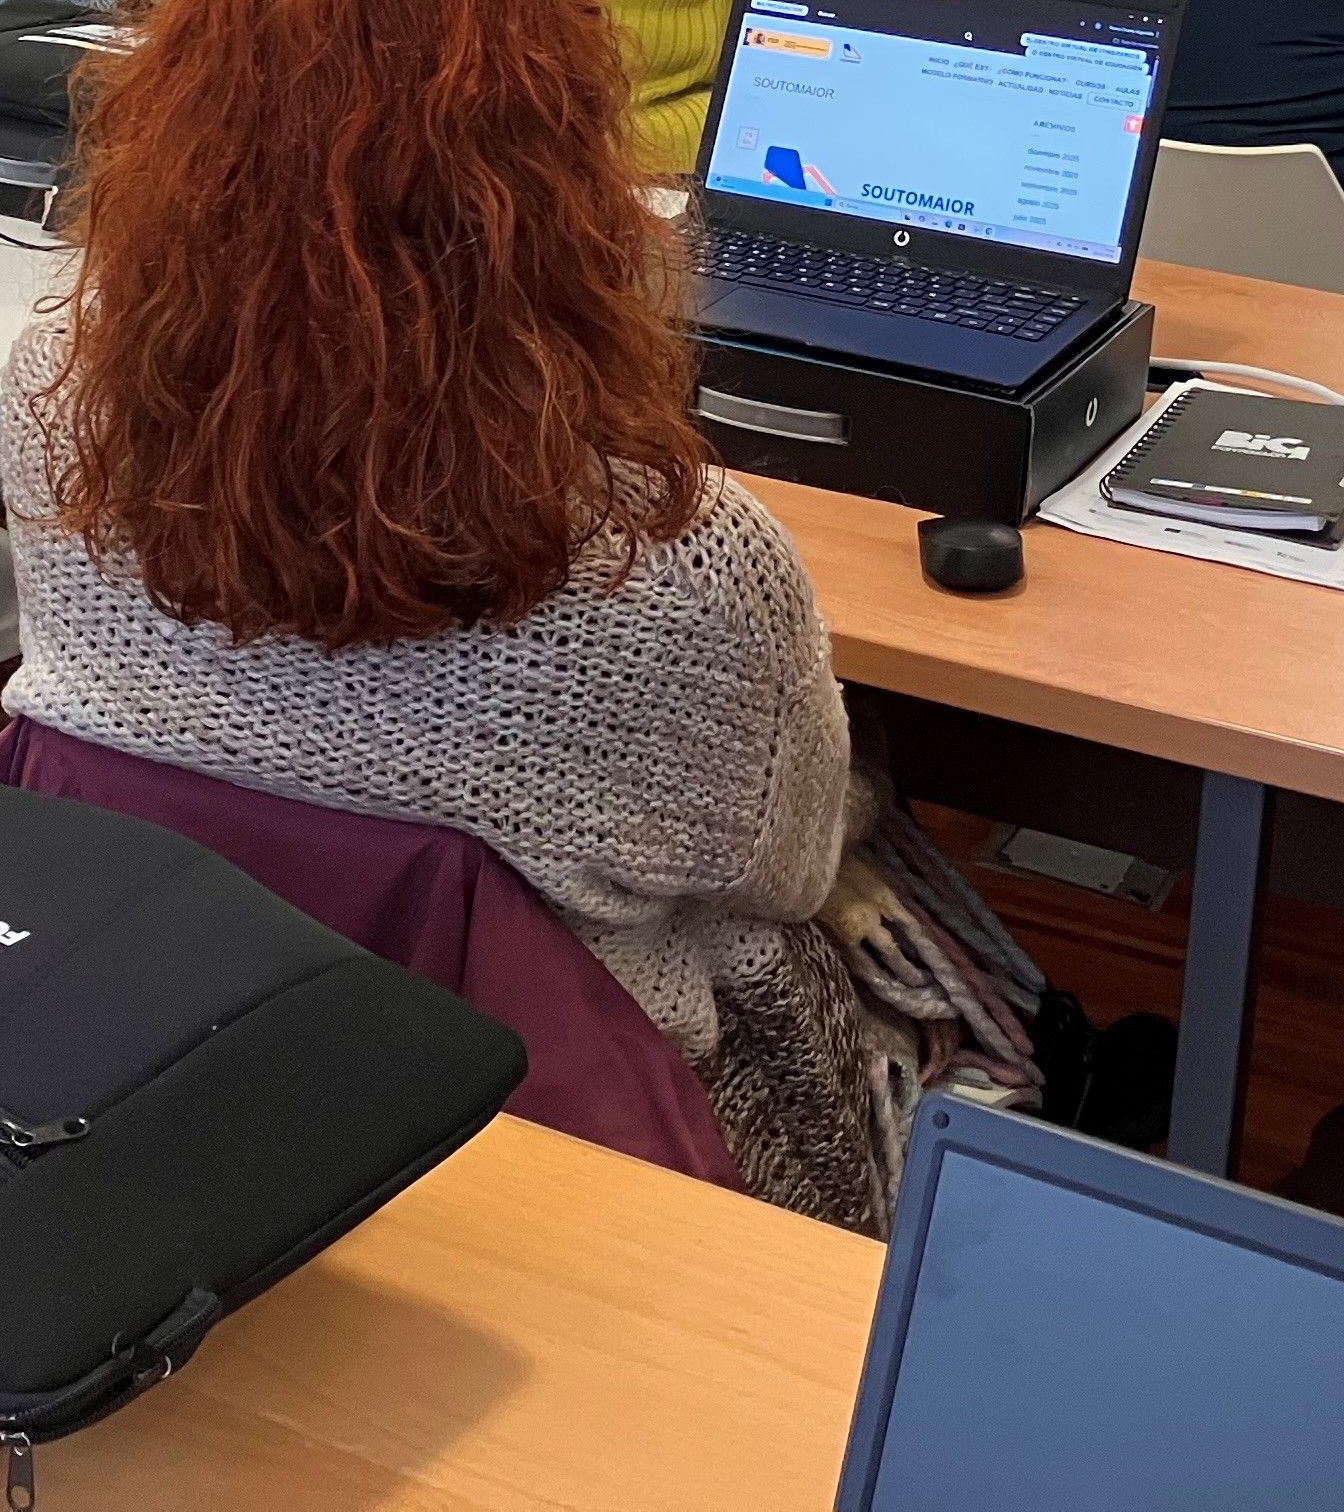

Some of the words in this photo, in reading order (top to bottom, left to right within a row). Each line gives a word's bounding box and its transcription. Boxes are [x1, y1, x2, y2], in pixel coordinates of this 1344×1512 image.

[753, 75, 835, 100] SOUTOMAIOR
[1075, 79, 1106, 90] CURSOS
[1115, 85, 1142, 96] AULAS
[1093, 95, 1134, 108] CONTACTO
[861, 183, 975, 217] SOUTOMAIOR
